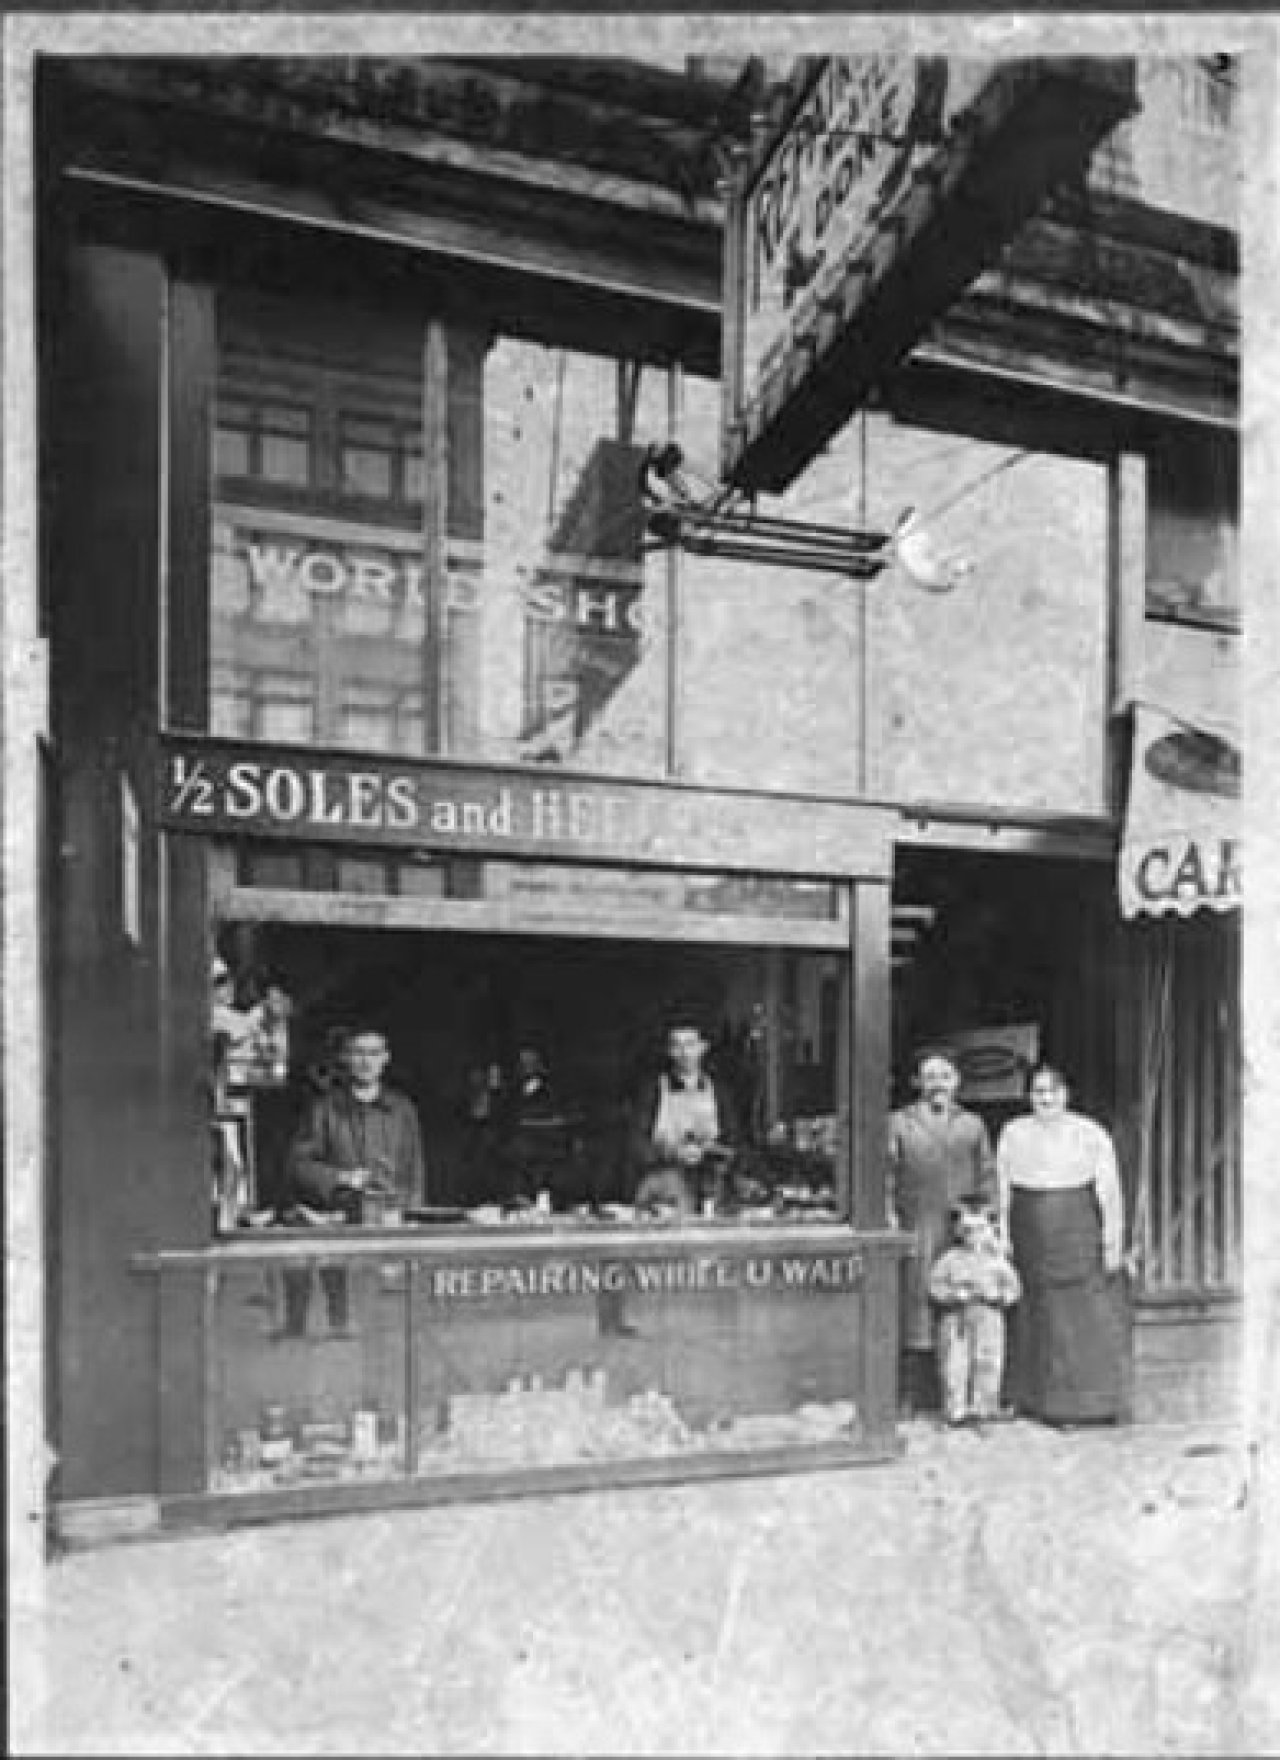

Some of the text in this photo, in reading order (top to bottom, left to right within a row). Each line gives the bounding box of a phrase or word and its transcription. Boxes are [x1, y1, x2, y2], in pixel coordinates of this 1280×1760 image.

[225, 762, 420, 830] SOLES
[430, 787, 511, 837] and
[434, 1261, 626, 1297] REPAIRING
[746, 1258, 771, 1287] U
[782, 1254, 864, 1286] WAIT
